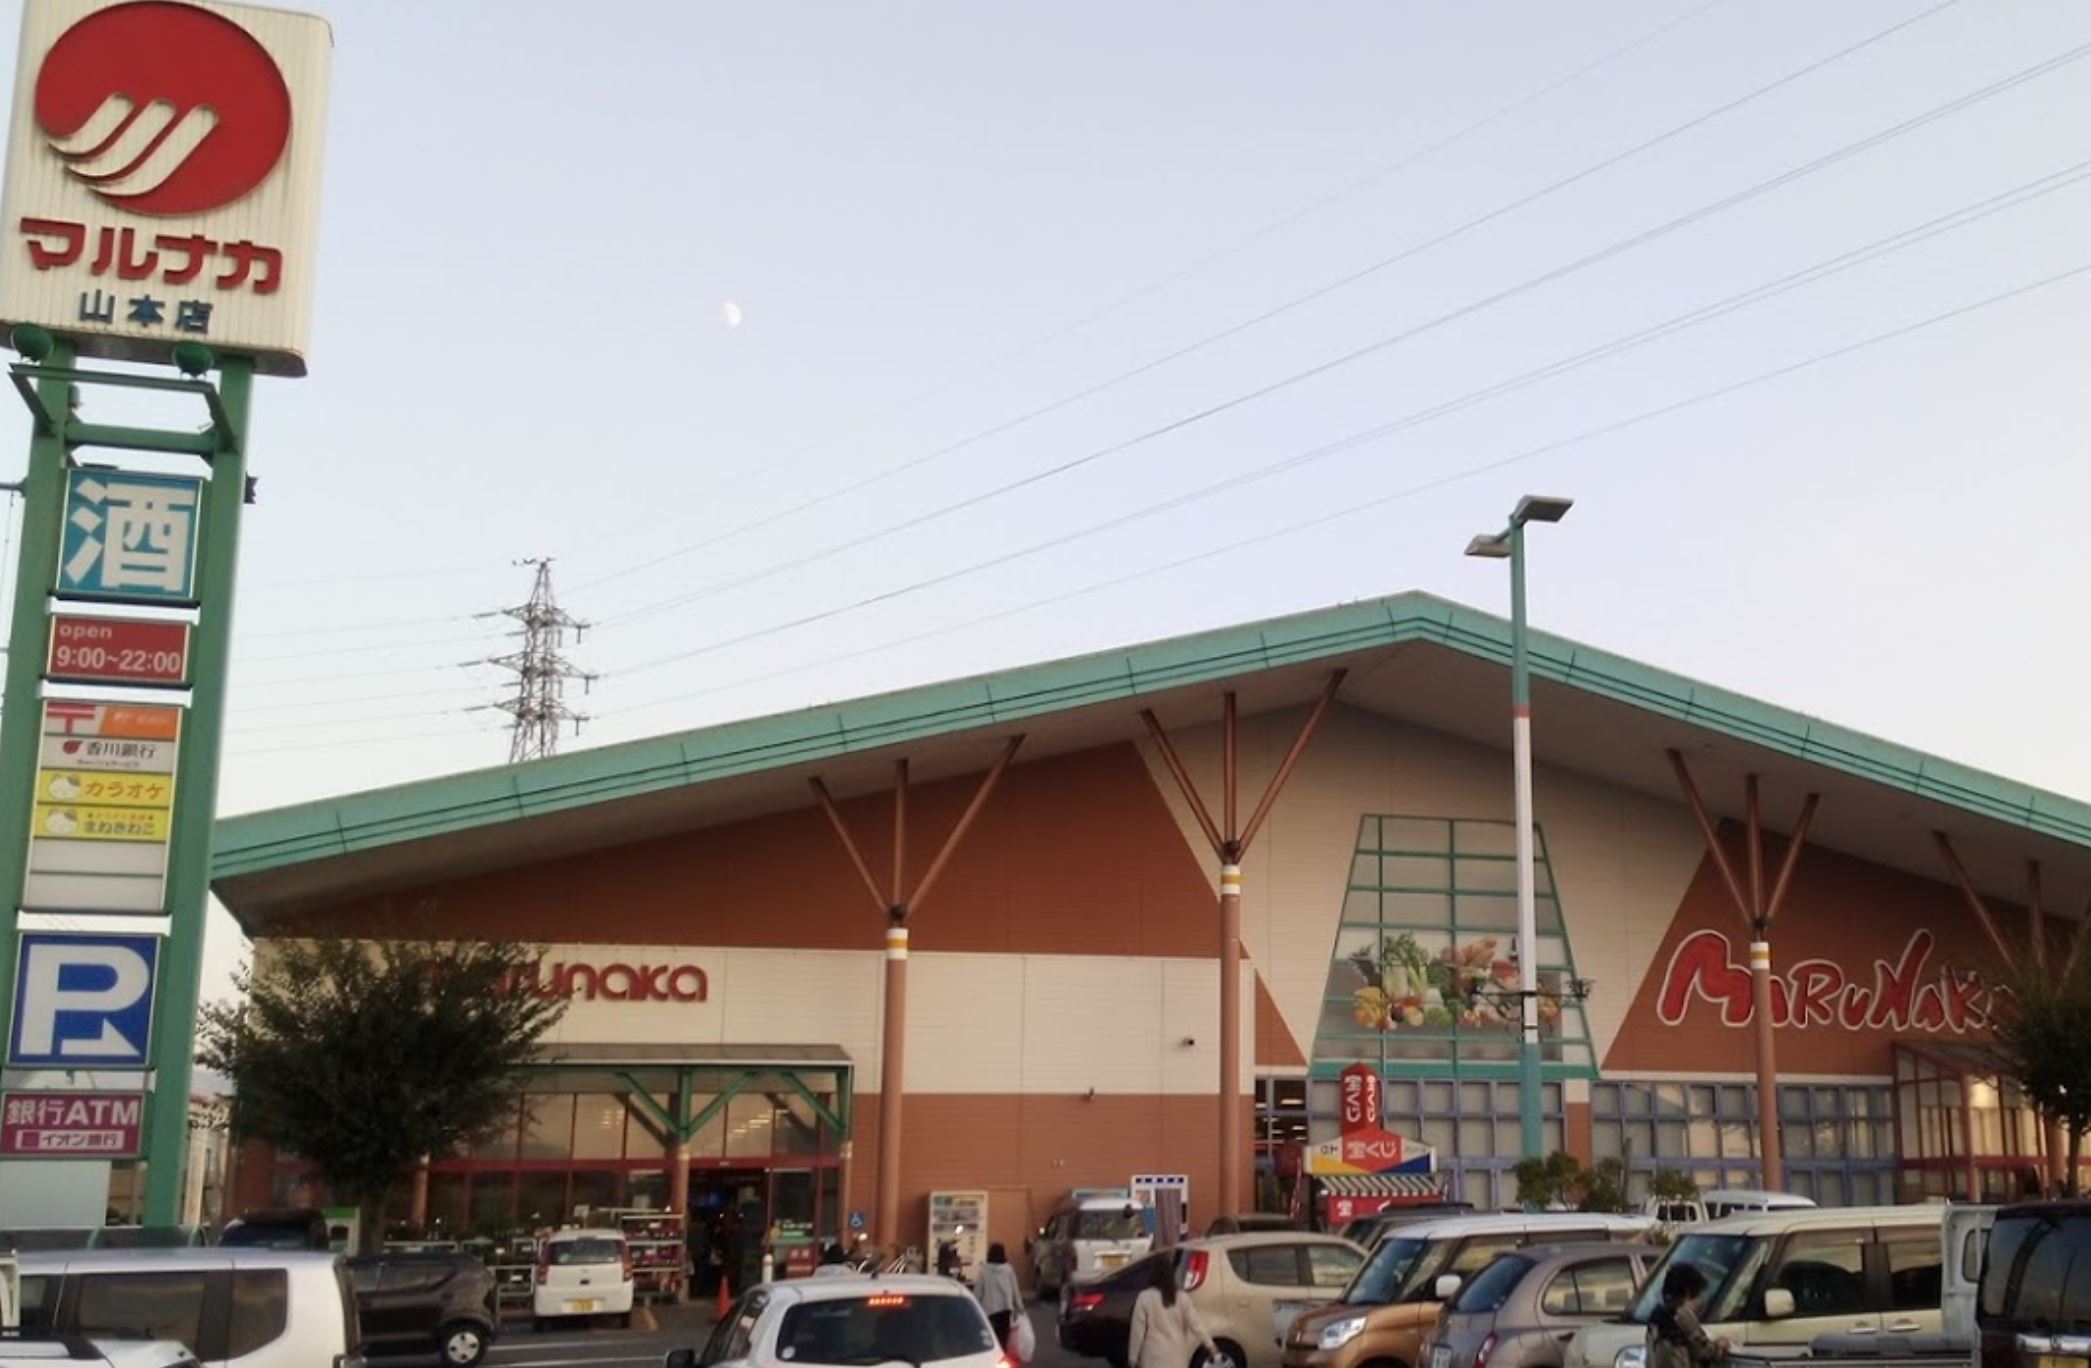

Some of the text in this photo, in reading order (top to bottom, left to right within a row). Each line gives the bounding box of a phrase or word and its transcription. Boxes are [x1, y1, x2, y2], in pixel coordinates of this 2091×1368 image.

[20, 217, 283, 295] マルナカ
[79, 289, 213, 335] 山本店
[65, 478, 197, 592] 酒
[59, 624, 113, 640] open
[85, 780, 164, 800] カラオケ
[19, 943, 150, 1056] P
[6, 1099, 138, 1126] 銀行ATM
[42, 1131, 118, 1147] イオン銀行
[1347, 1140, 1397, 1160] 宝くじ
